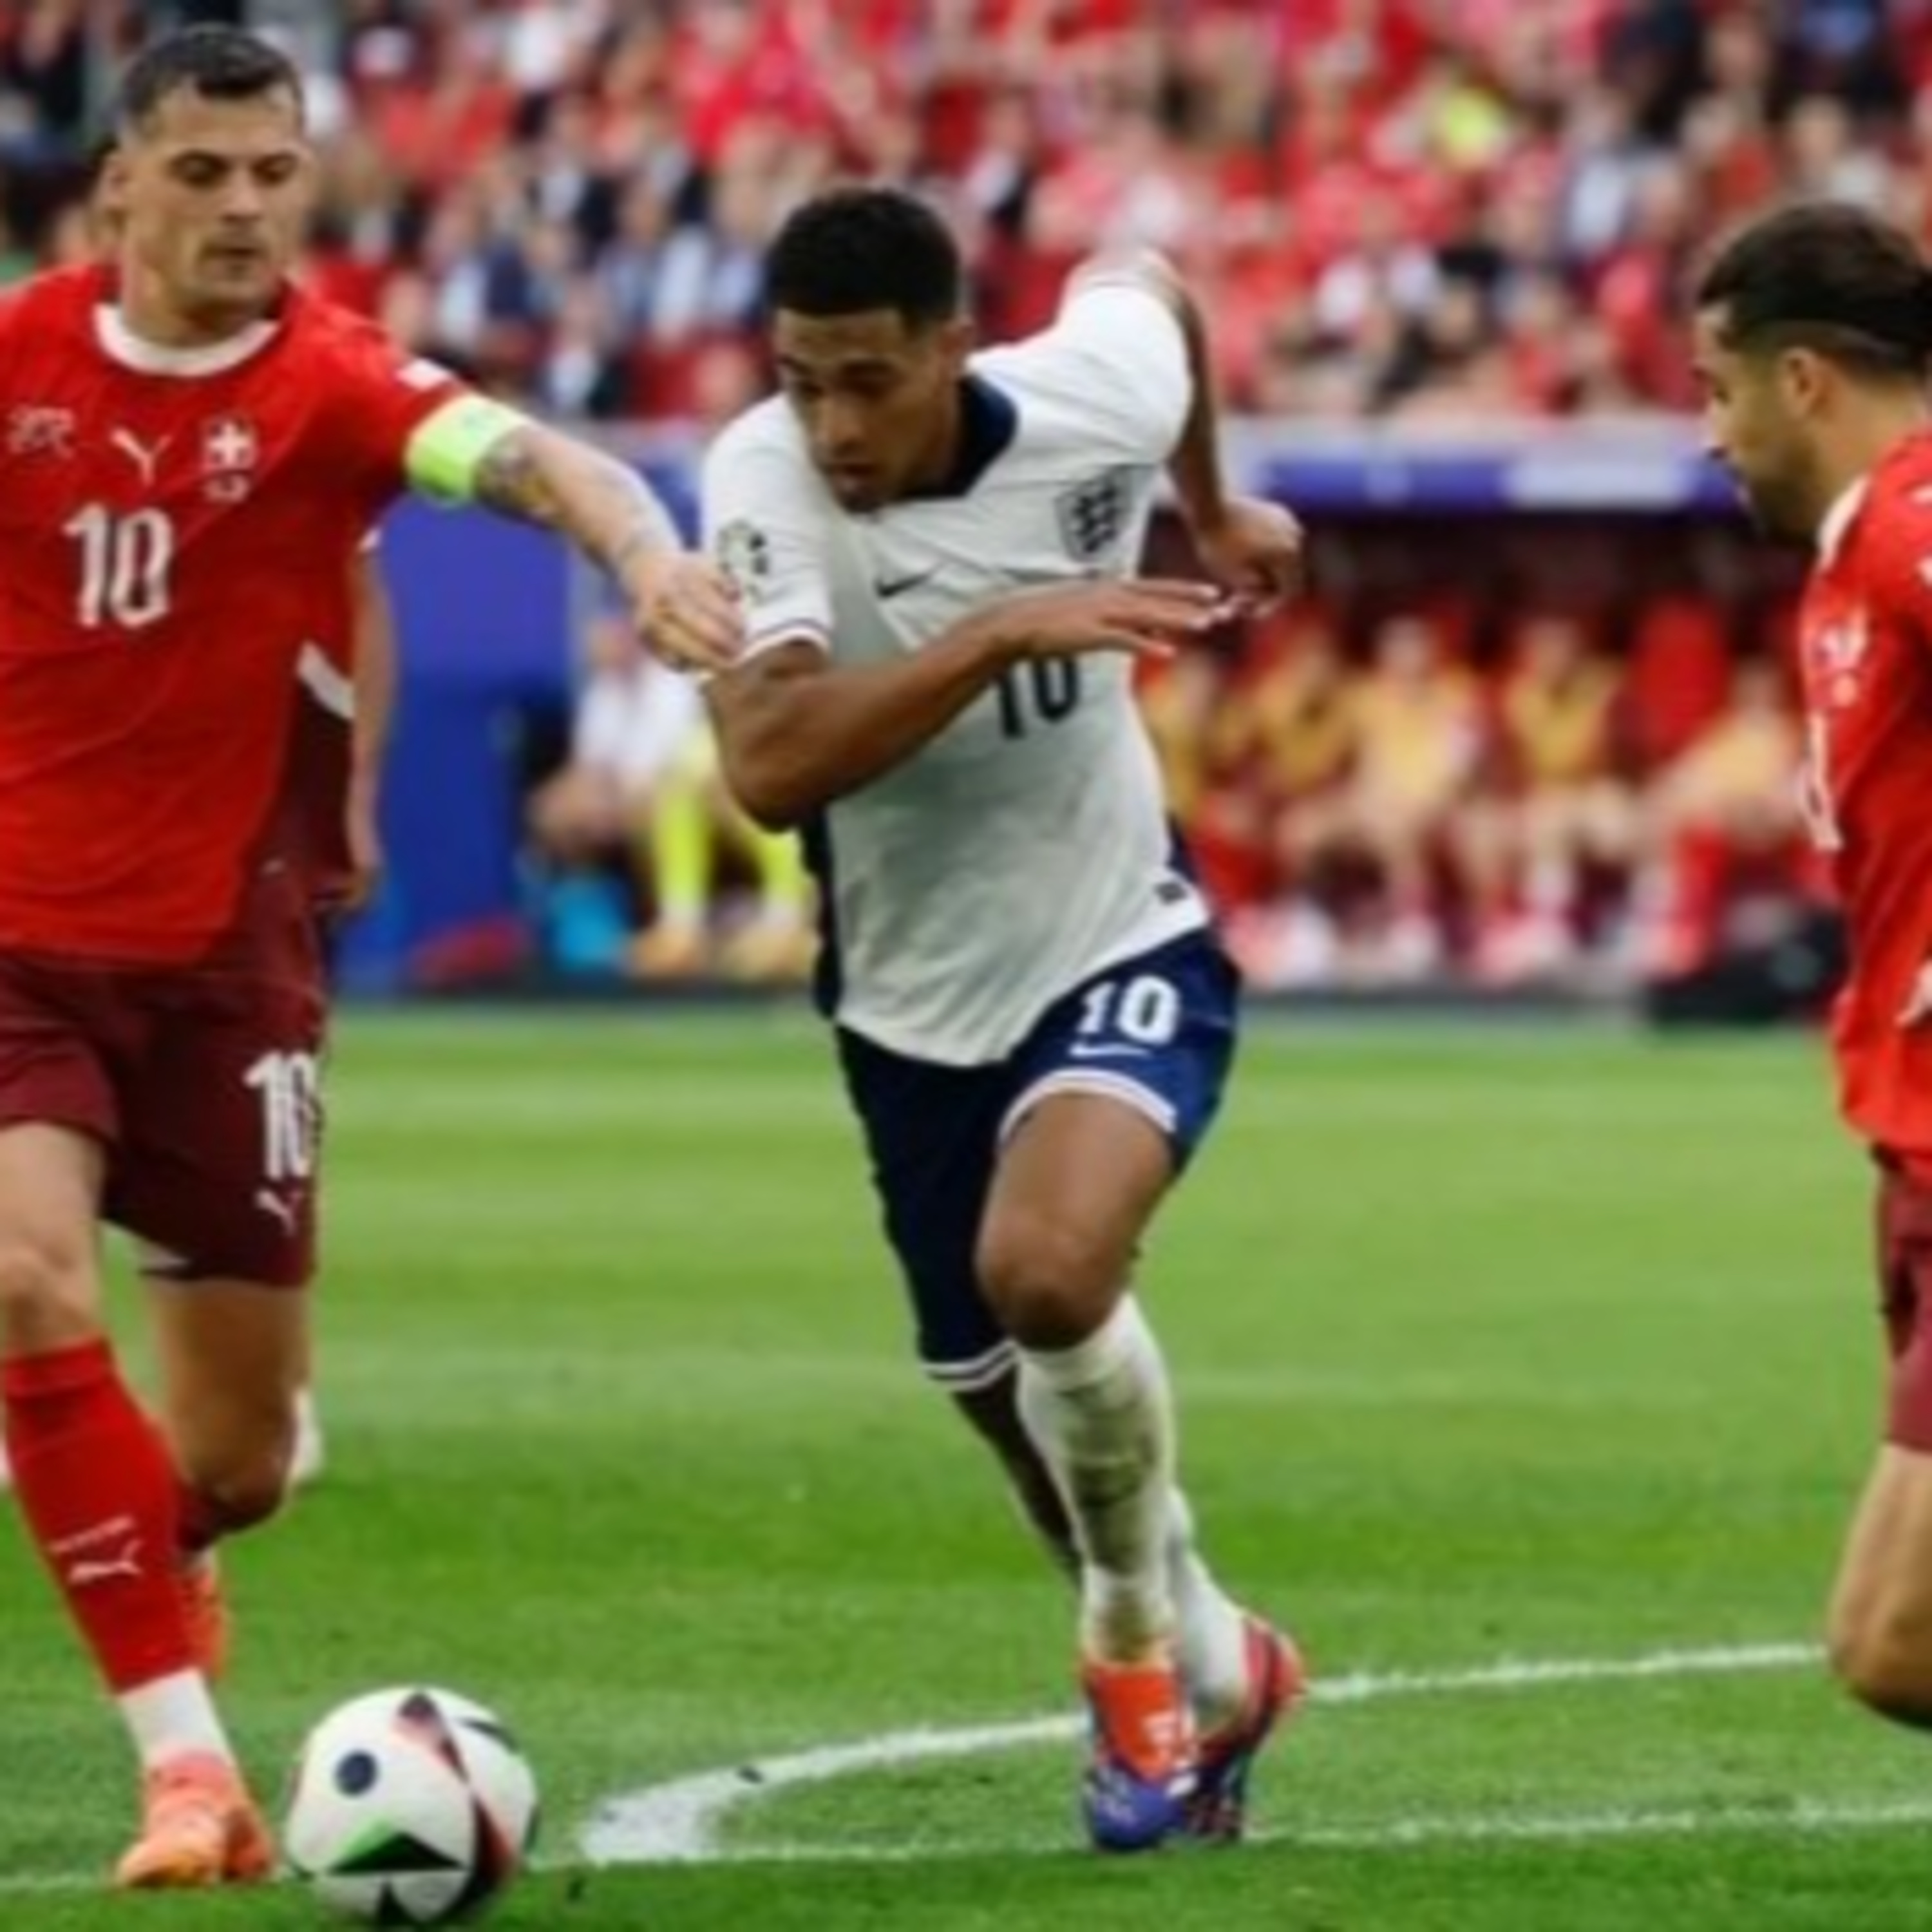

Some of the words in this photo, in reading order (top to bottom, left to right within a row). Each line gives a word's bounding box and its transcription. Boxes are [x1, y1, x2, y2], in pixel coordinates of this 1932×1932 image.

[64, 502, 173, 627] 10
[996, 655, 1079, 739] 10
[1077, 975, 1180, 1045] 10
[243, 1050, 316, 1179] 10
